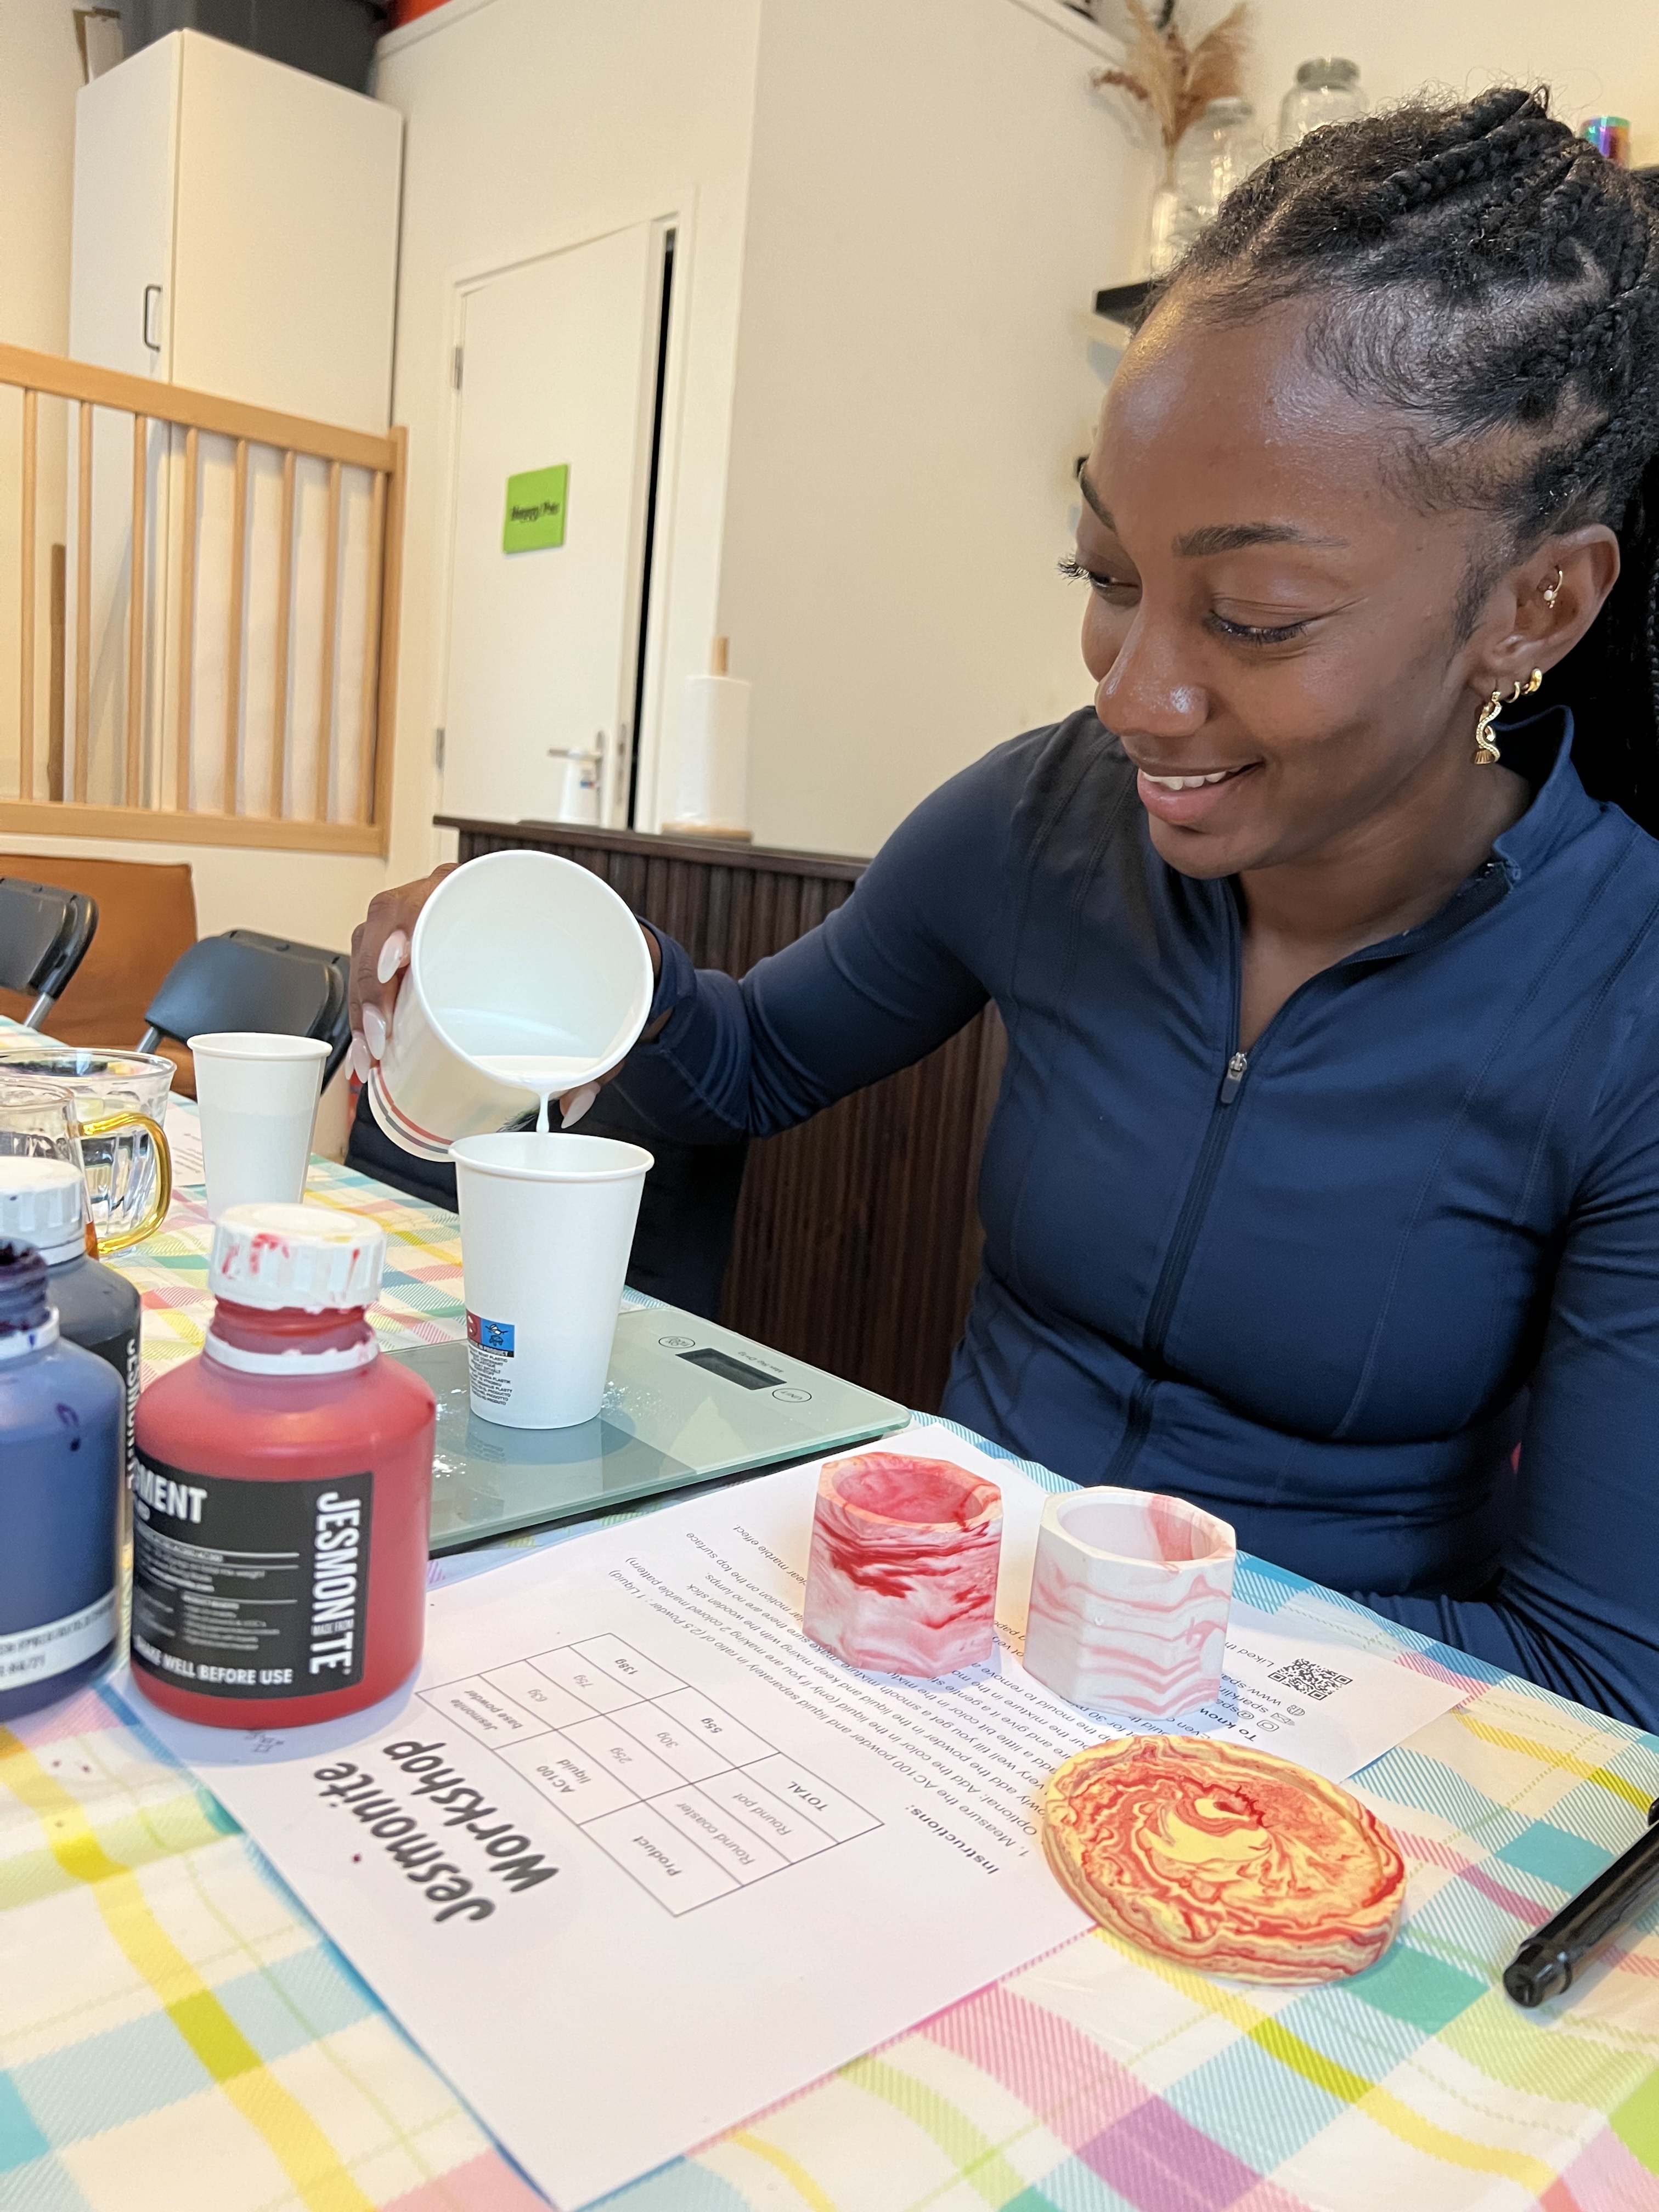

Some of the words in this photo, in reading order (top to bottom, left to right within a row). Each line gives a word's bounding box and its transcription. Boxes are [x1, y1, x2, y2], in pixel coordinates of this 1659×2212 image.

[133, 1458, 208, 1523] MENT
[730, 1524, 759, 1545] effect.
[686, 1532, 718, 1559] surface
[716, 1559, 732, 1572] top
[758, 1545, 789, 1570] marble
[624, 1557, 663, 1585] pattern)
[730, 1571, 747, 1583] the
[786, 1570, 806, 1584] lear
[608, 1570, 640, 1594] Liquid)
[686, 1583, 709, 1599] stick
[704, 1574, 733, 1595] lumps.
[745, 1582, 760, 1592] on
[658, 1585, 690, 1606] marble
[731, 1594, 747, 1602] no
[758, 1591, 792, 1612] motion
[649, 1602, 686, 1624] Powder
[685, 1605, 724, 1626] colored
[707, 1598, 744, 1621] wooden
[744, 1602, 763, 1612] are
[743, 1620, 761, 1631] the
[761, 1612, 788, 1628] there
[729, 1630, 766, 1654] making
[759, 1630, 781, 1644] with
[786, 1628, 810, 1643] sure
[714, 1641, 738, 1656] ratio
[779, 1644, 815, 1666] mixing
[1236, 1648, 1274, 1667] Liked
[613, 1658, 638, 1675] 138g
[736, 1656, 749, 1664] in
[764, 1654, 784, 1666] are
[196, 1663, 257, 1686] BEFORE
[258, 1668, 294, 1685] USE
[572, 1674, 594, 1688] 75g
[746, 1663, 800, 1700] separately
[781, 1666, 806, 1680] you
[812, 1666, 841, 1684] keep
[980, 1667, 1024, 1692] remove
[526, 1688, 548, 1702] 63g
[809, 1685, 840, 1703] (only
[836, 1682, 862, 1696] and
[917, 1688, 937, 1700] the
[945, 1685, 983, 1706] gentle
[970, 1680, 991, 1693] the
[463, 1690, 504, 1713] powder
[858, 1695, 893, 1715] liquid
[879, 1685, 922, 1710] smooth
[936, 1699, 950, 1707] in
[990, 1692, 1004, 1700] in
[1024, 1692, 1037, 1701] to
[449, 1699, 498, 1730] Jesmonite
[795, 1699, 830, 1720] liquid
[834, 1702, 870, 1723] liquid
[947, 1707, 979, 1724] color
[1003, 1699, 1048, 1725] mixture
[1035, 1700, 1075, 1722] mould
[1088, 1711, 1107, 1720] 30
[496, 1712, 523, 1730] base
[700, 1717, 723, 1734] 55g
[825, 1718, 852, 1733] and
[868, 1721, 889, 1734] the
[891, 1713, 912, 1726] the
[928, 1716, 954, 1728] get
[1001, 1717, 1029, 1732] give
[1075, 1722, 1097, 1734] the
[1107, 1722, 1126, 1732] for
[887, 1733, 902, 1742] in
[911, 1725, 925, 1734] in
[951, 1728, 978, 1743] you
[977, 1723, 996, 1735] bit
[1048, 1725, 1069, 1738] the
[1238, 1728, 1256, 1742] To
[656, 1731, 679, 1748] 30g
[849, 1734, 898, 1760] powder
[923, 1734, 972, 1762] powder
[972, 1742, 991, 1753] till
[996, 1734, 1023, 1752] little
[1025, 1732, 1052, 1747] and
[608, 1747, 633, 1764] 25g
[899, 1742, 932, 1760] color
[931, 1760, 953, 1776] the
[969, 1762, 991, 1777] the
[988, 1752, 1016, 1770] well
[536, 1765, 575, 1793] AC100
[555, 1758, 591, 1784] liquid
[891, 1760, 938, 1788] AC100
[1015, 1770, 1045, 1790] very
[949, 1775, 981, 1793] Add
[988, 1776, 1017, 1794] add
[731, 1792, 758, 1808] pot
[787, 1781, 828, 1812] TOTAL
[936, 1789, 958, 1805] the
[1015, 1795, 1046, 1815] owly
[382, 1740, 559, 1893] Workshop
[675, 1802, 718, 1833] coaster
[749, 1807, 792, 1836] Round
[979, 1793, 1037, 1835] Optional:
[958, 1805, 1017, 1847] Measure
[313, 1762, 495, 1922] Jesmonite
[905, 1804, 999, 1875] Instructions:
[631, 1835, 682, 1876] Product
[712, 1833, 755, 1865] Round
